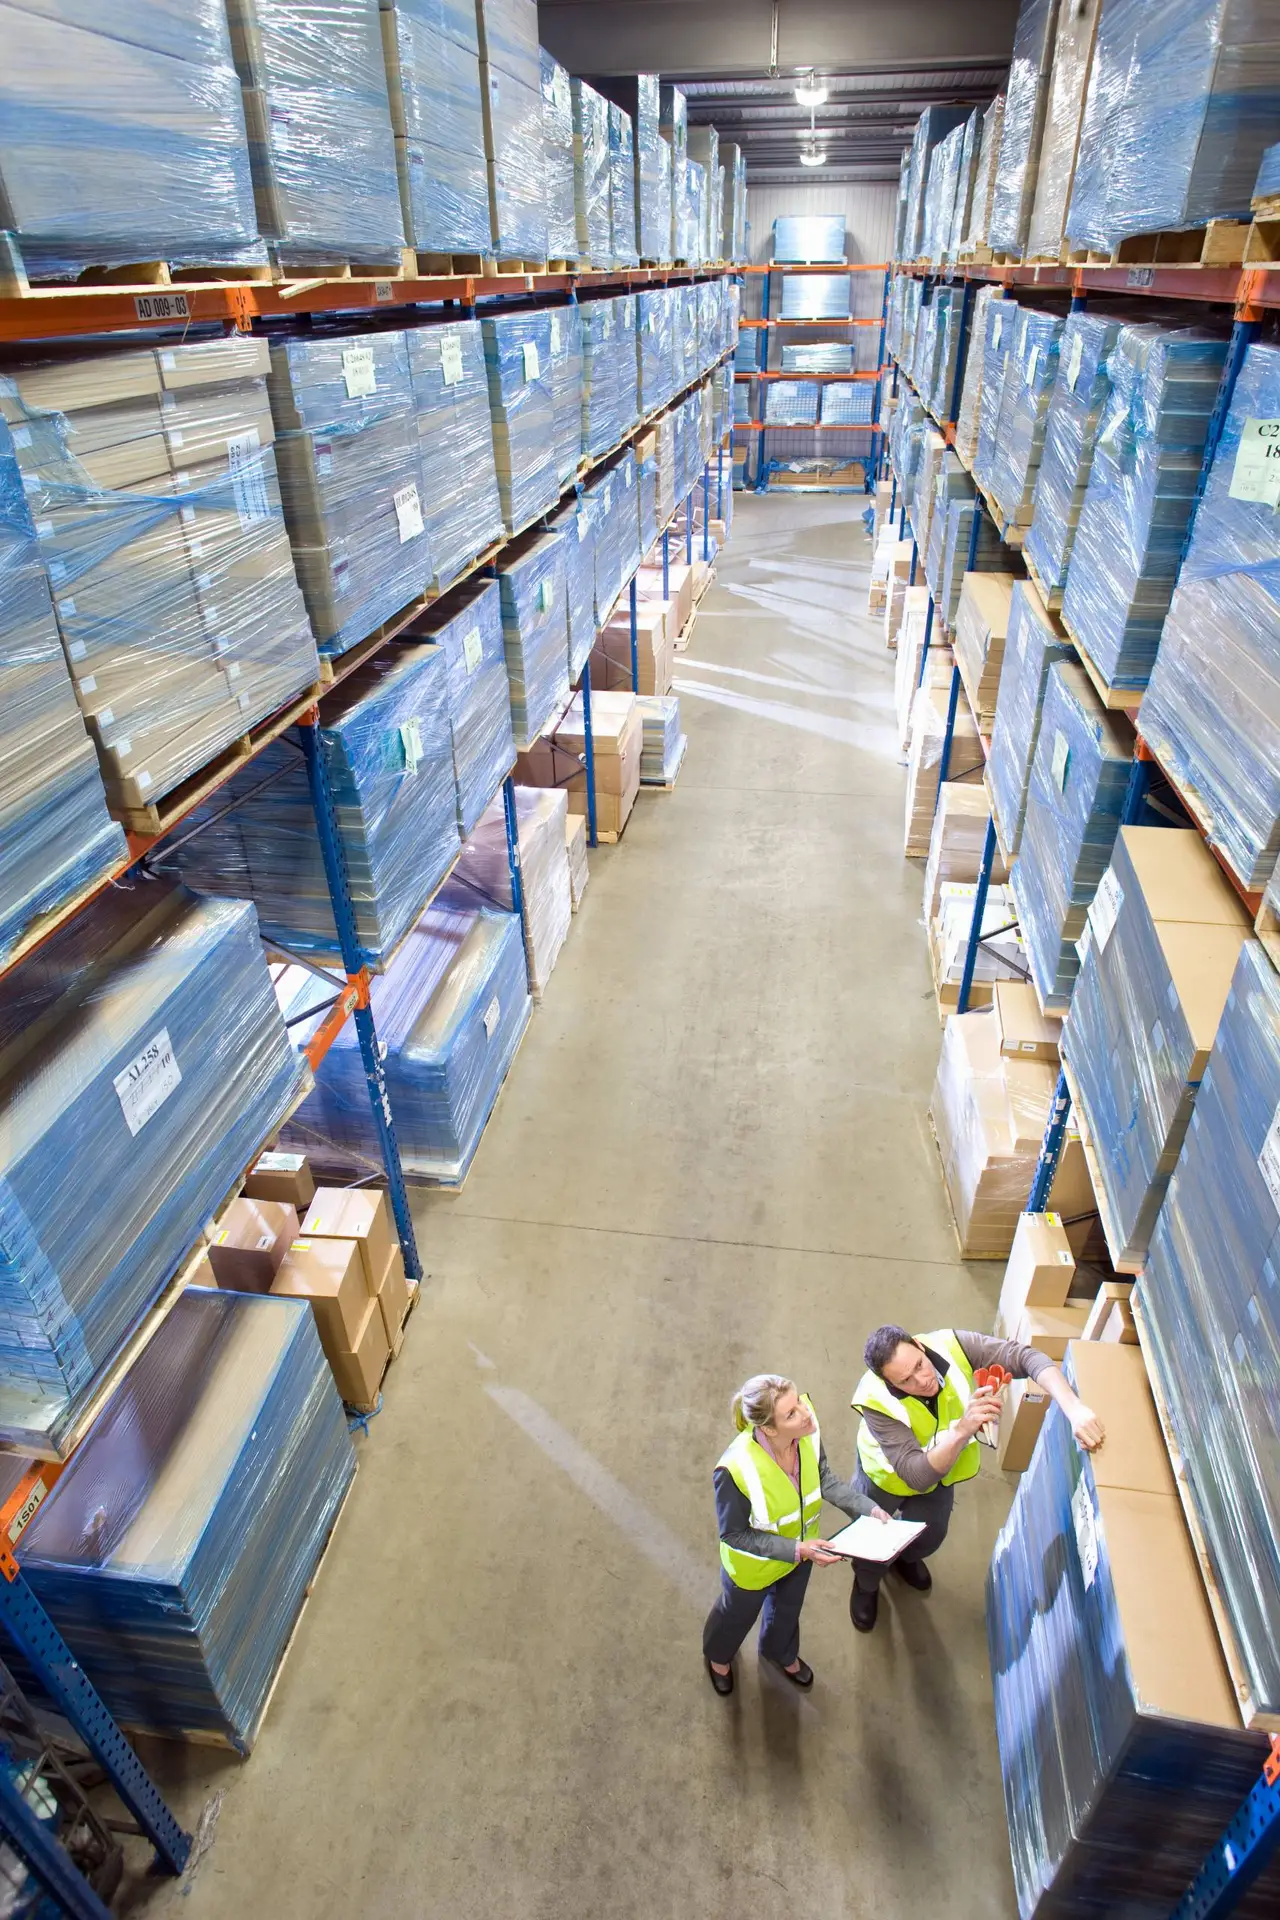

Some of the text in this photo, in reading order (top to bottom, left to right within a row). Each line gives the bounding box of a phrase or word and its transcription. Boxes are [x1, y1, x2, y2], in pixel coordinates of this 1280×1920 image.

[138, 296, 187, 318] AD 009-03
[161, 1053, 171, 1069] 10
[16, 1495, 39, 1528] 1S01
